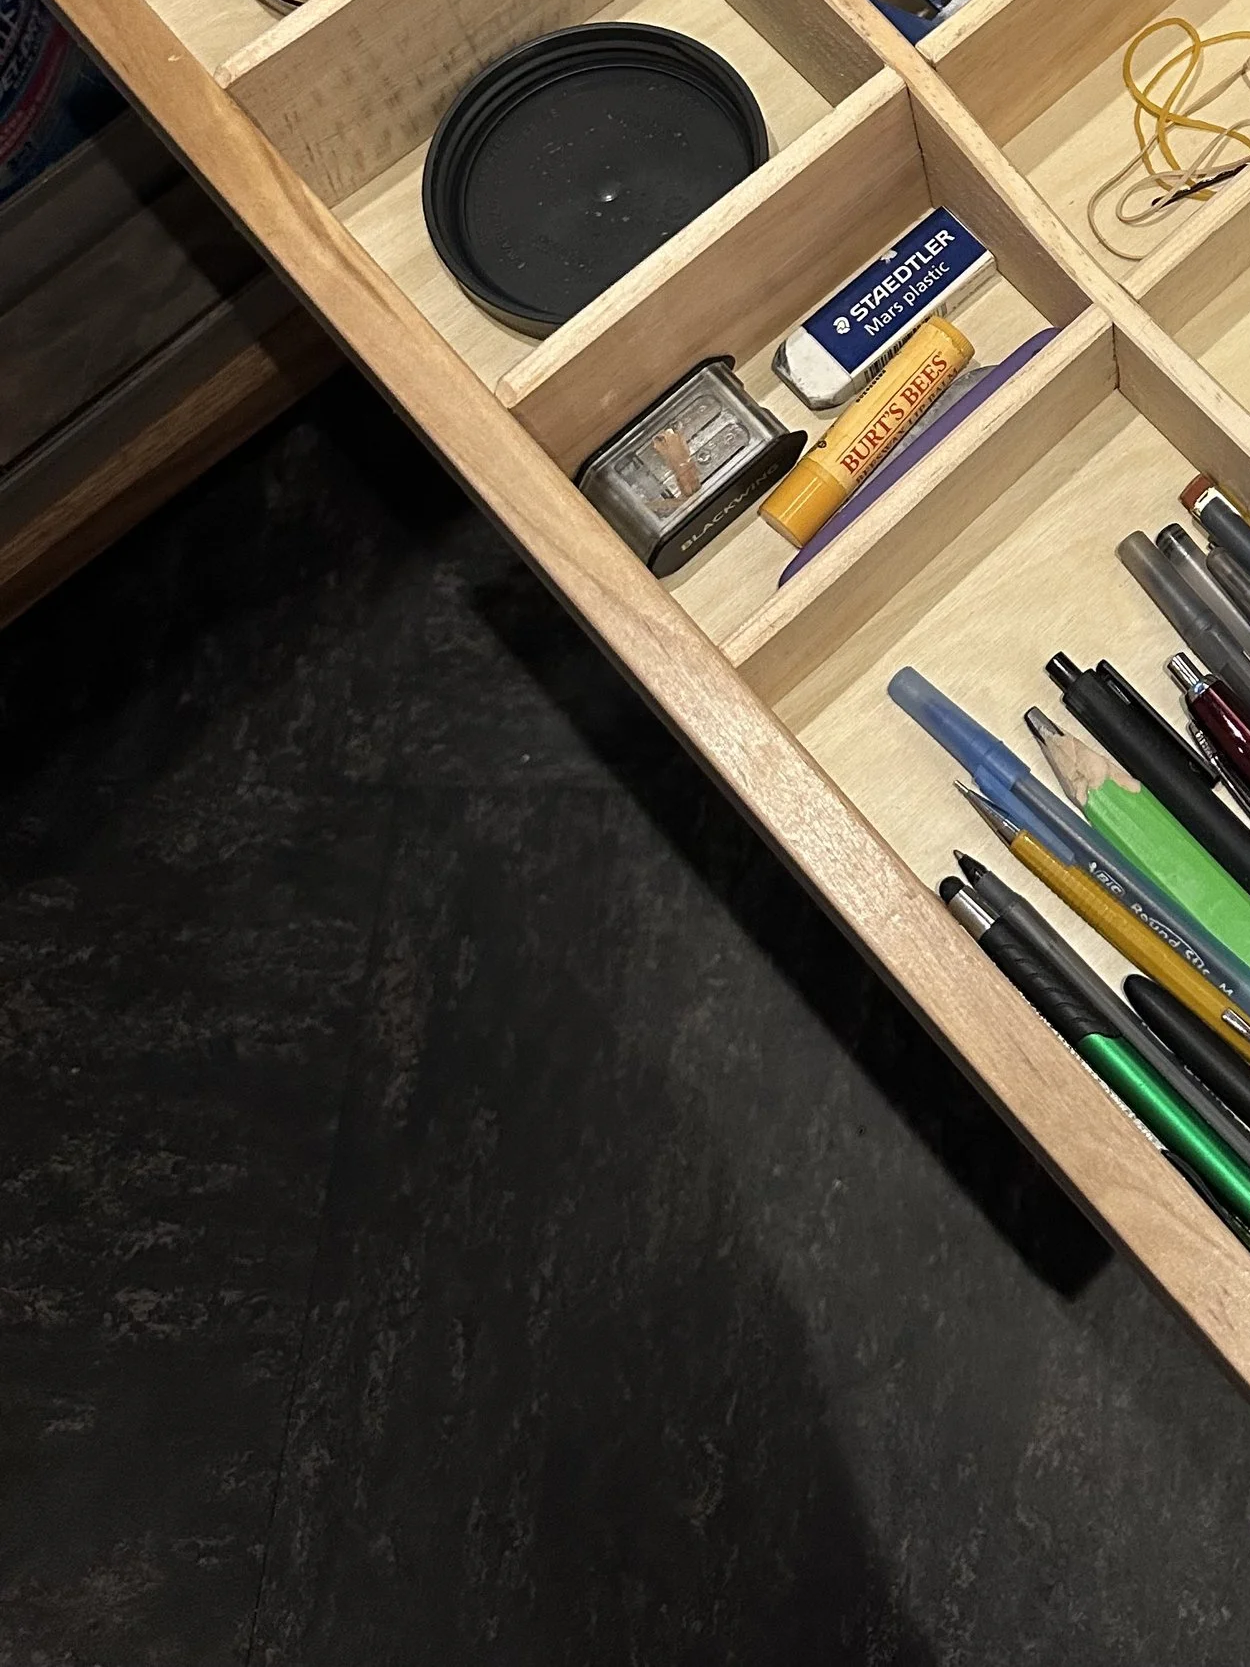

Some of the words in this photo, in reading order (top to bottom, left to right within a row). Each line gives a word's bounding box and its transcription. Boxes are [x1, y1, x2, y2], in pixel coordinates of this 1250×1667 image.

[850, 230, 955, 322] STAEDTLER
[864, 302, 904, 336] Mars
[902, 261, 950, 307] plastic
[900, 354, 948, 407] BEES
[681, 462, 780, 552] BLACKWING
[1095, 870, 1122, 896] BIC
[1129, 901, 1180, 949] Round
[1181, 948, 1212, 977] Stic
